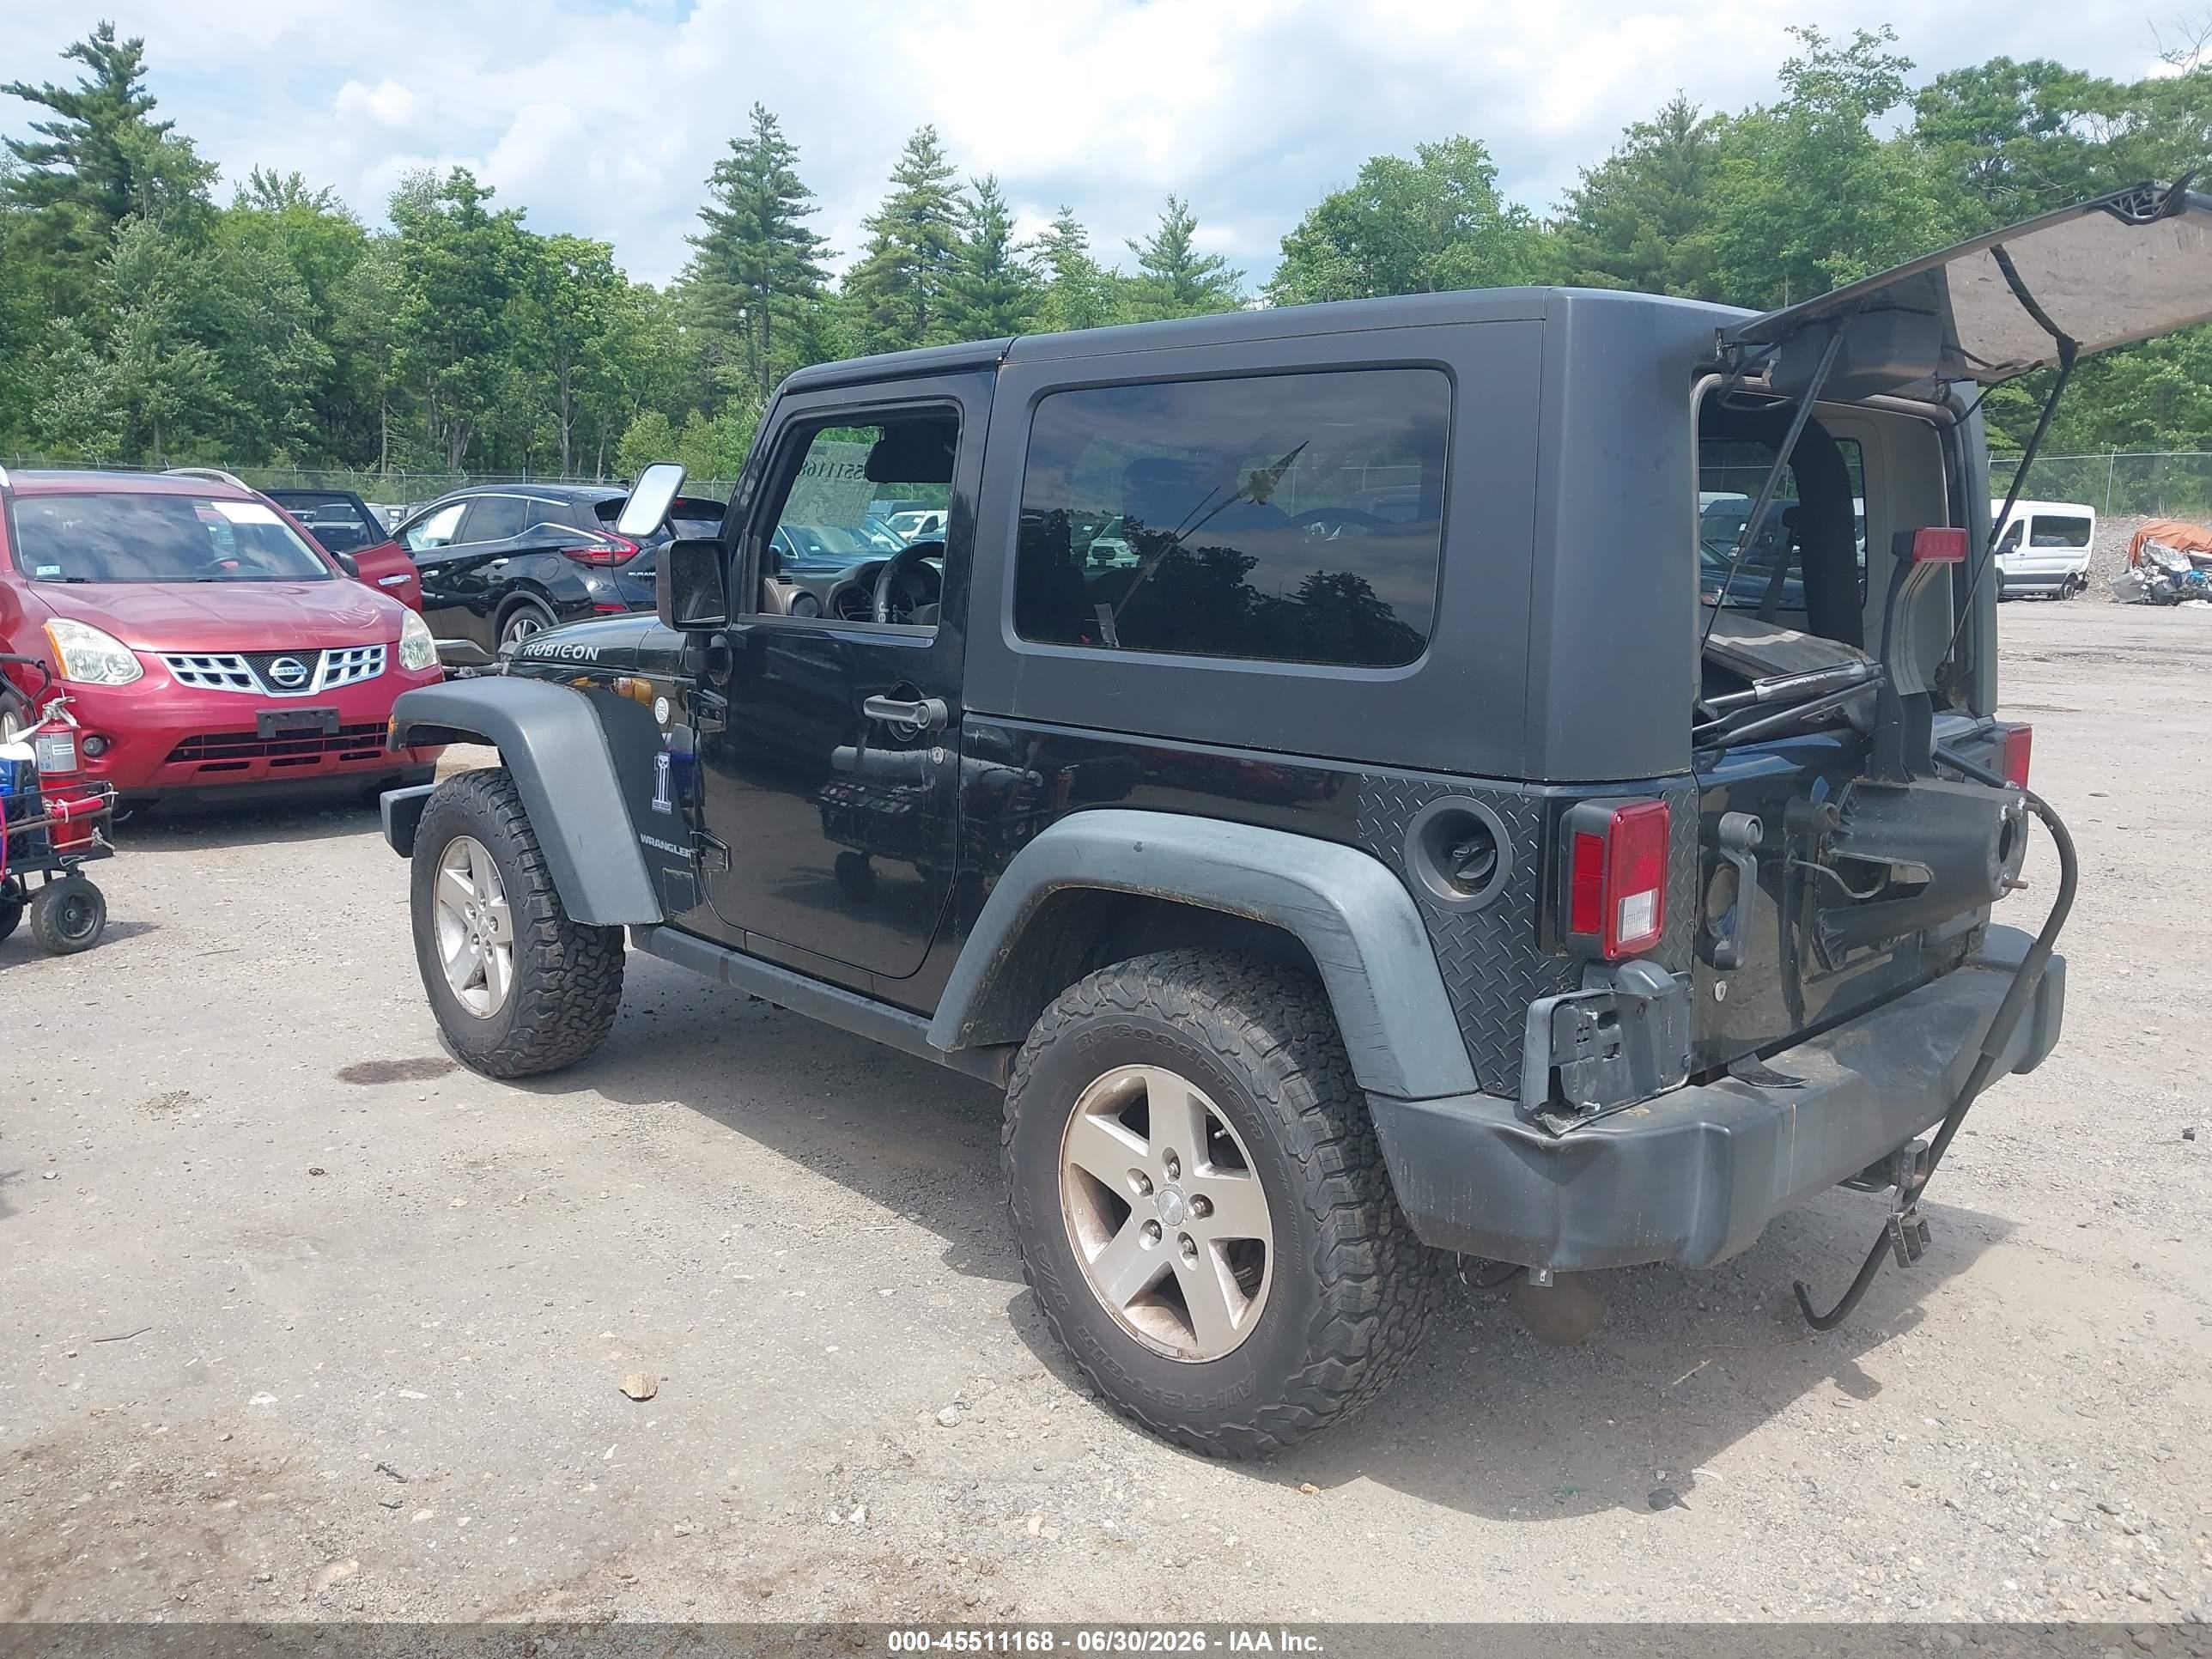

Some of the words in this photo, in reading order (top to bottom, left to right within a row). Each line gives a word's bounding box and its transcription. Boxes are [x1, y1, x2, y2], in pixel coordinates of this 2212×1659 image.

[523, 644, 599, 661] RUBICON
[640, 833, 692, 858] WRANGLER
[1074, 1023, 1265, 1139] BFGoodrich
